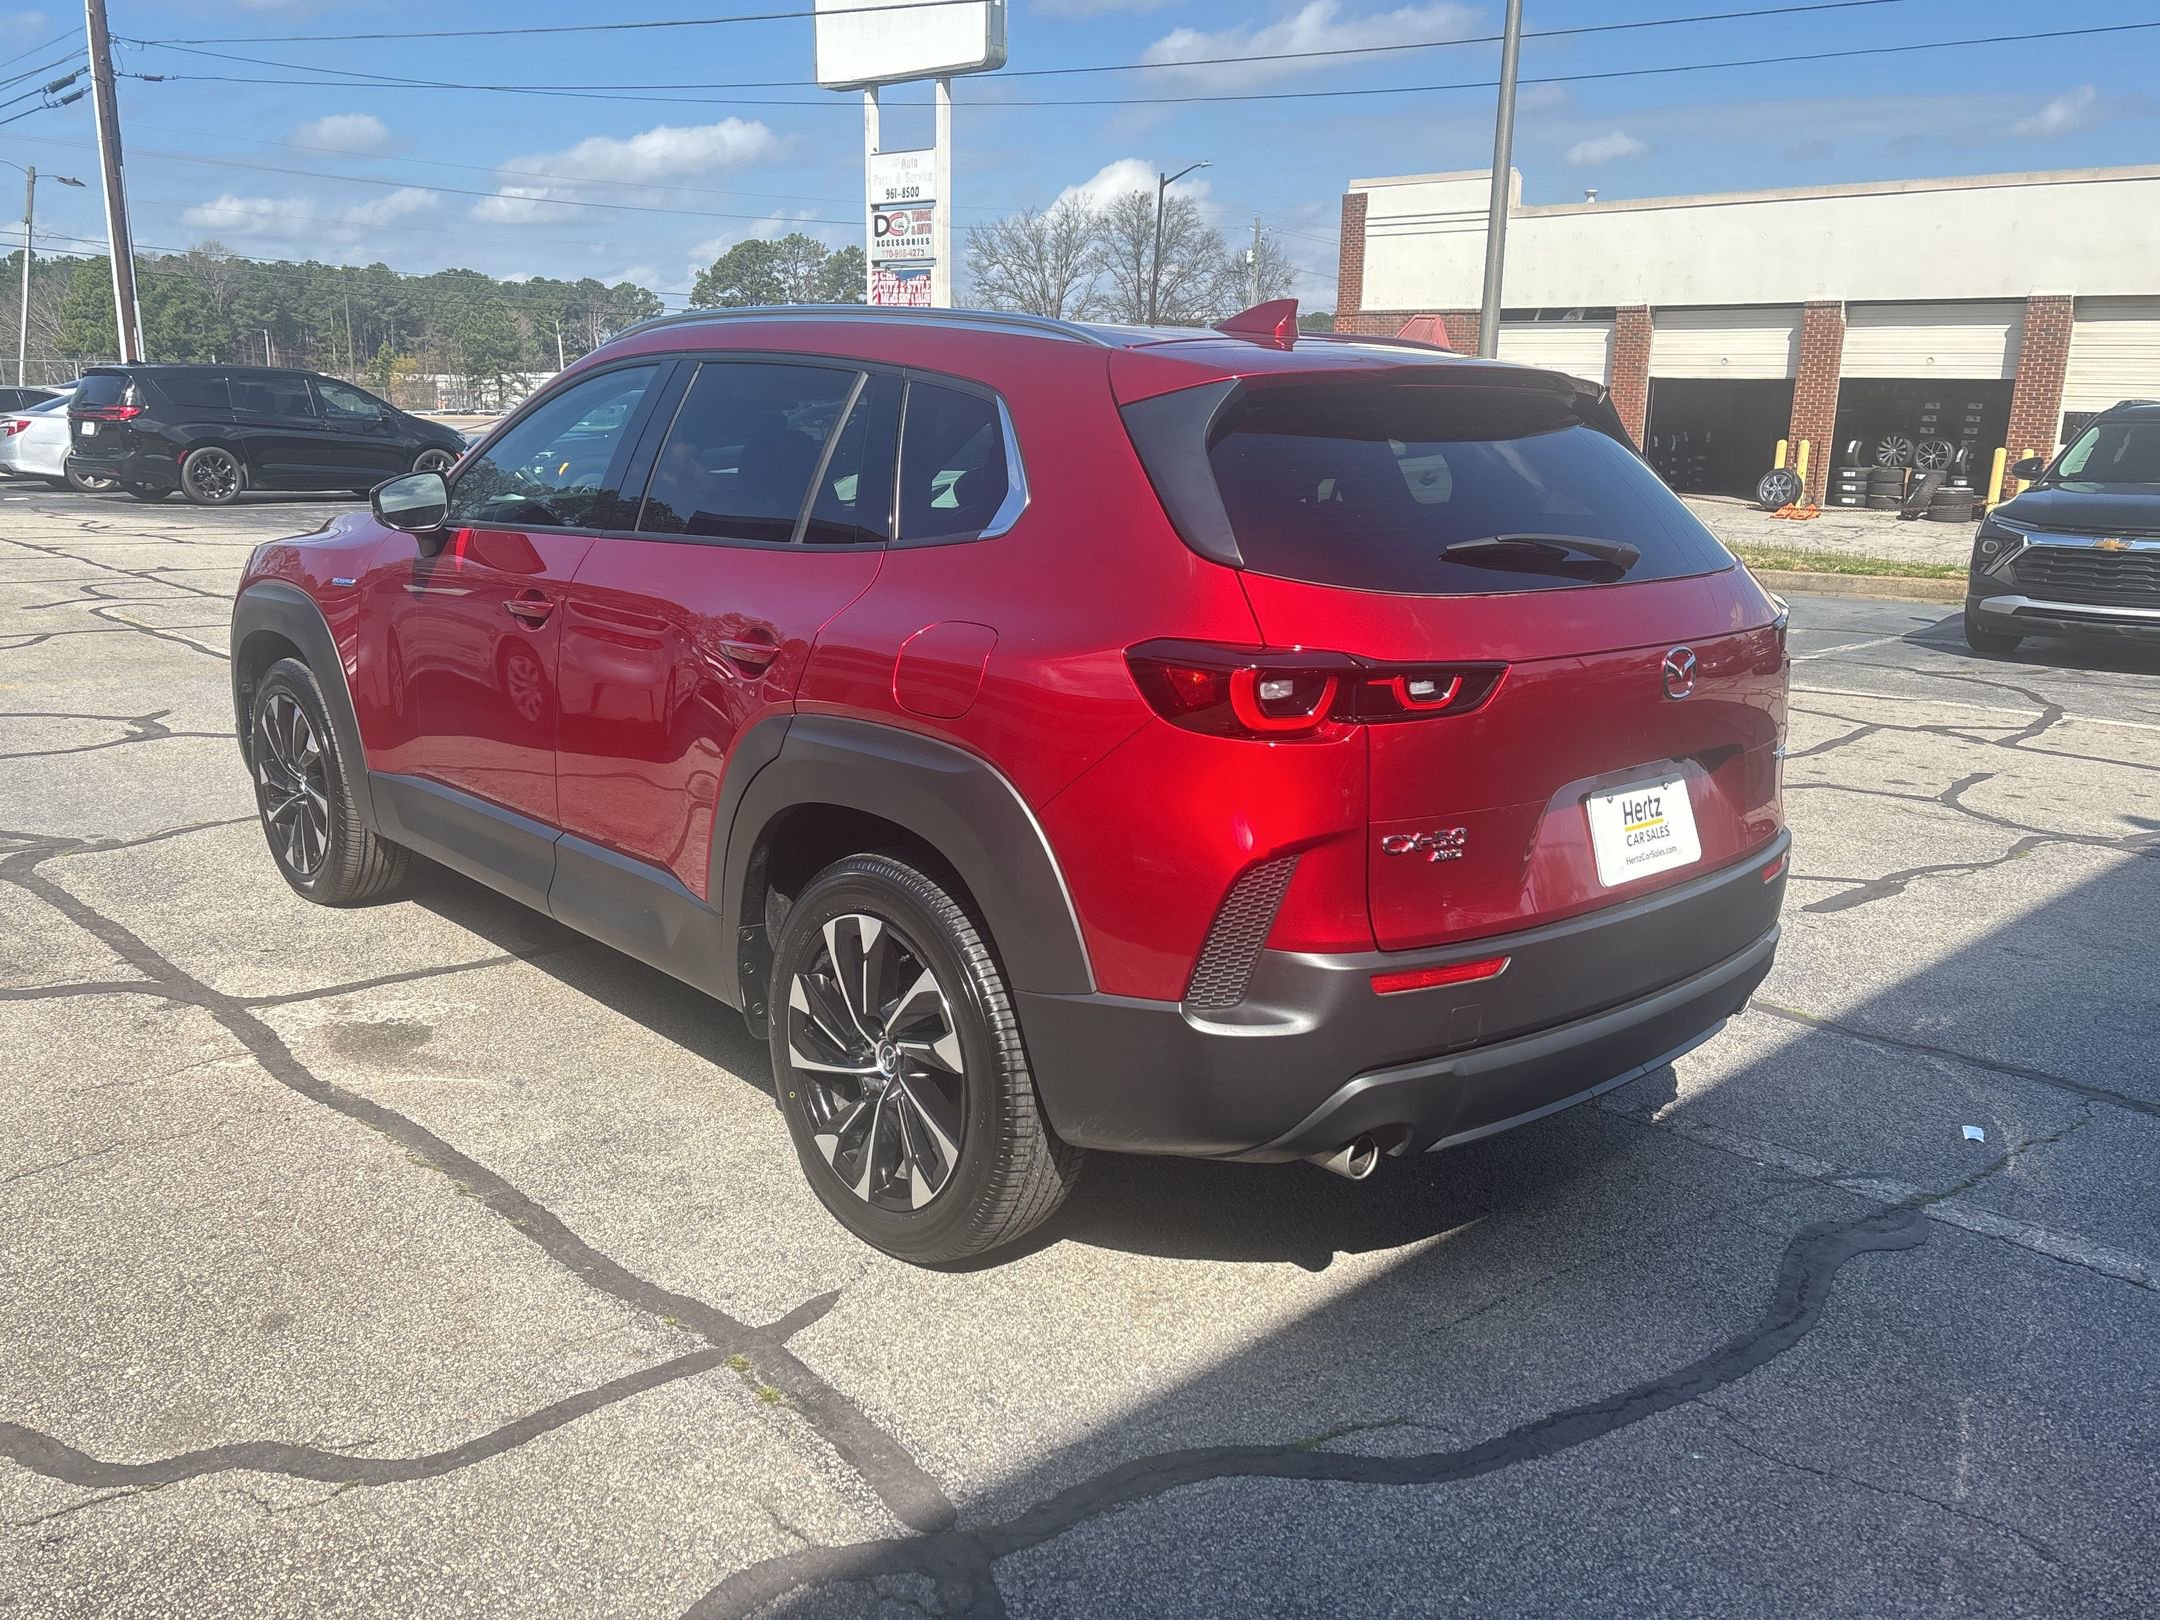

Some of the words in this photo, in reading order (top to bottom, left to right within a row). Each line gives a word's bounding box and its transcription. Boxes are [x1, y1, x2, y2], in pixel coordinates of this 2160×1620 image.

[901, 156, 919, 169] Auto
[885, 185, 920, 200] 961-8500
[876, 237, 930, 247] ACCESSORIES
[878, 280, 899, 293] CUTZ
[907, 279, 931, 293] STYLE
[1622, 795, 1663, 825] Hertz
[1382, 827, 1468, 855] CX-50
[1626, 831, 1645, 847] CAR
[1646, 824, 1671, 842] SALES
[1625, 845, 1678, 866] HertzCarSales.com
